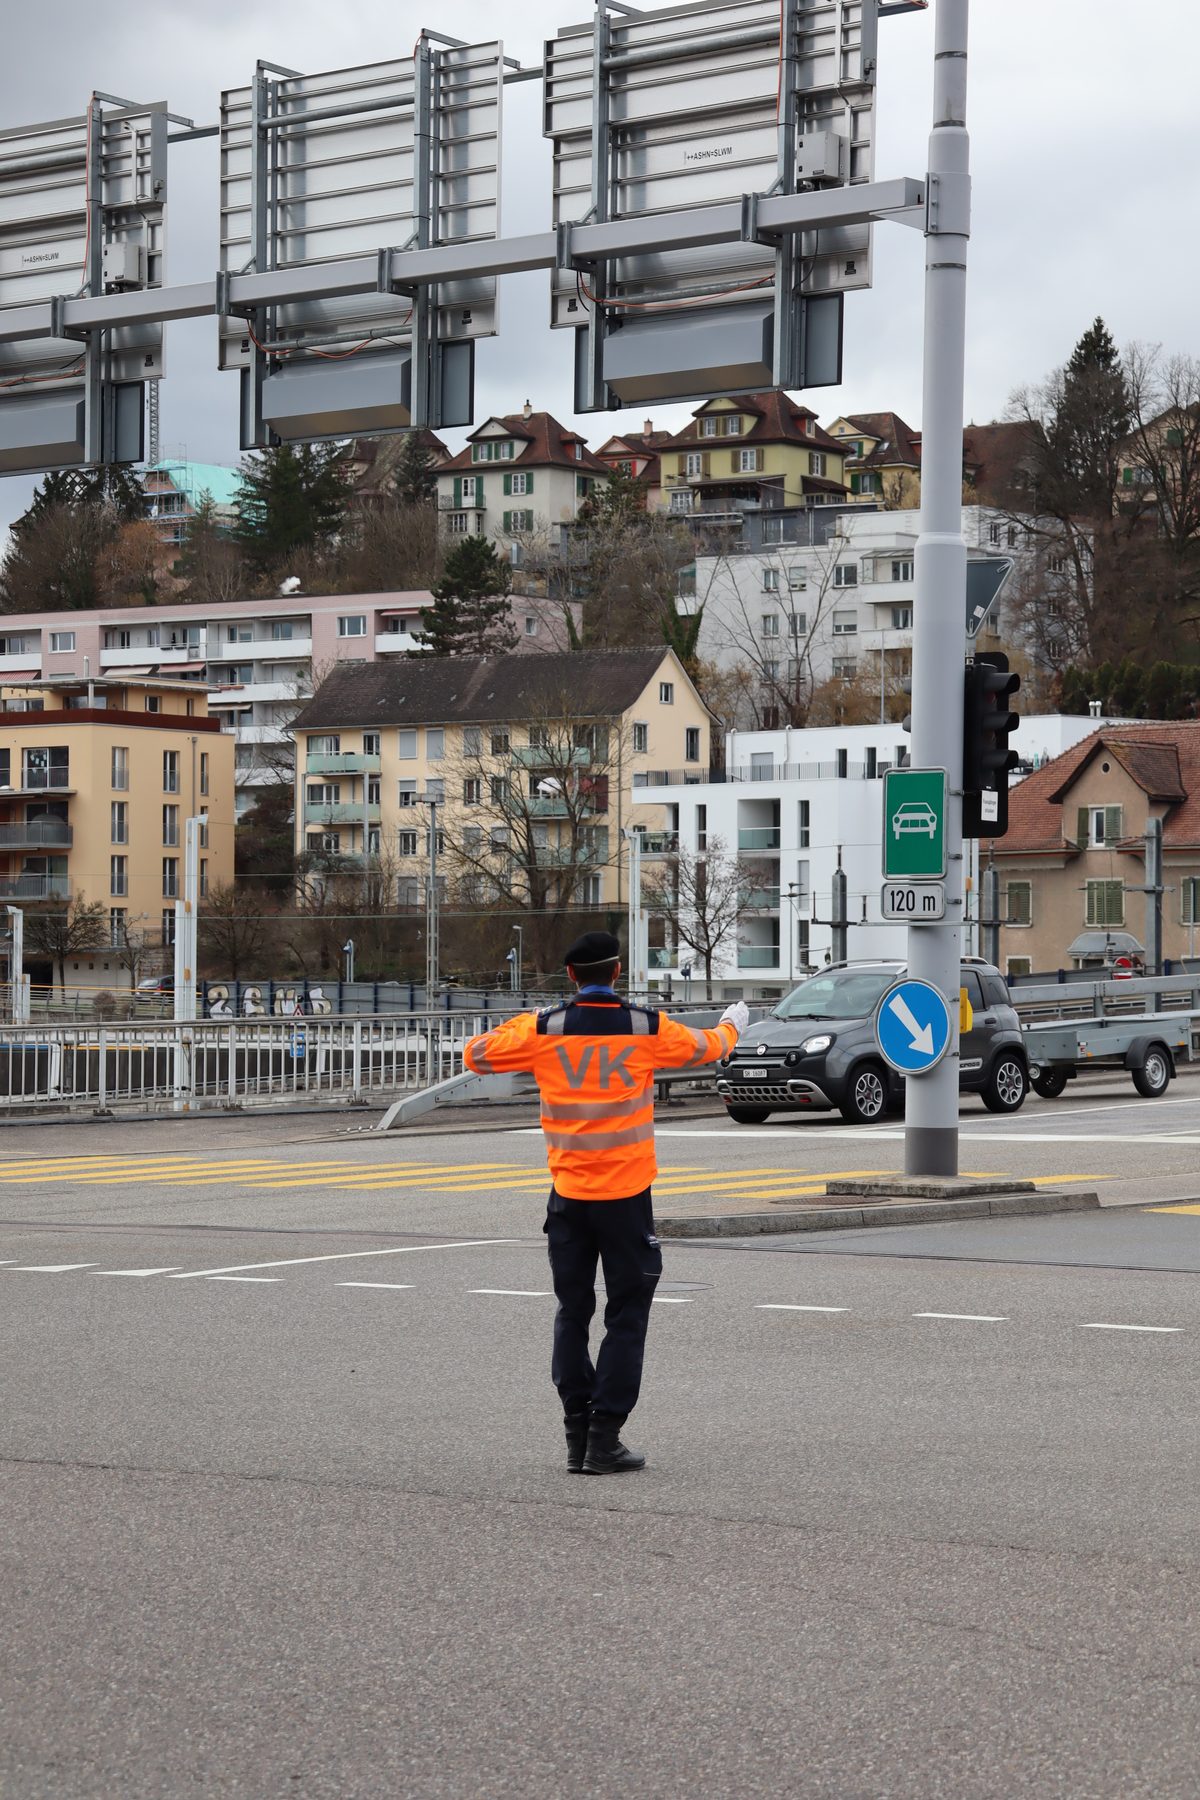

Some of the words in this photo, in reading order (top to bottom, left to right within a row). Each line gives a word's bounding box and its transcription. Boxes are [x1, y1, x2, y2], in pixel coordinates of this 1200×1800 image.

[890, 890, 916, 912] 120
[922, 895, 936, 912] m
[554, 1045, 638, 1089] VK
